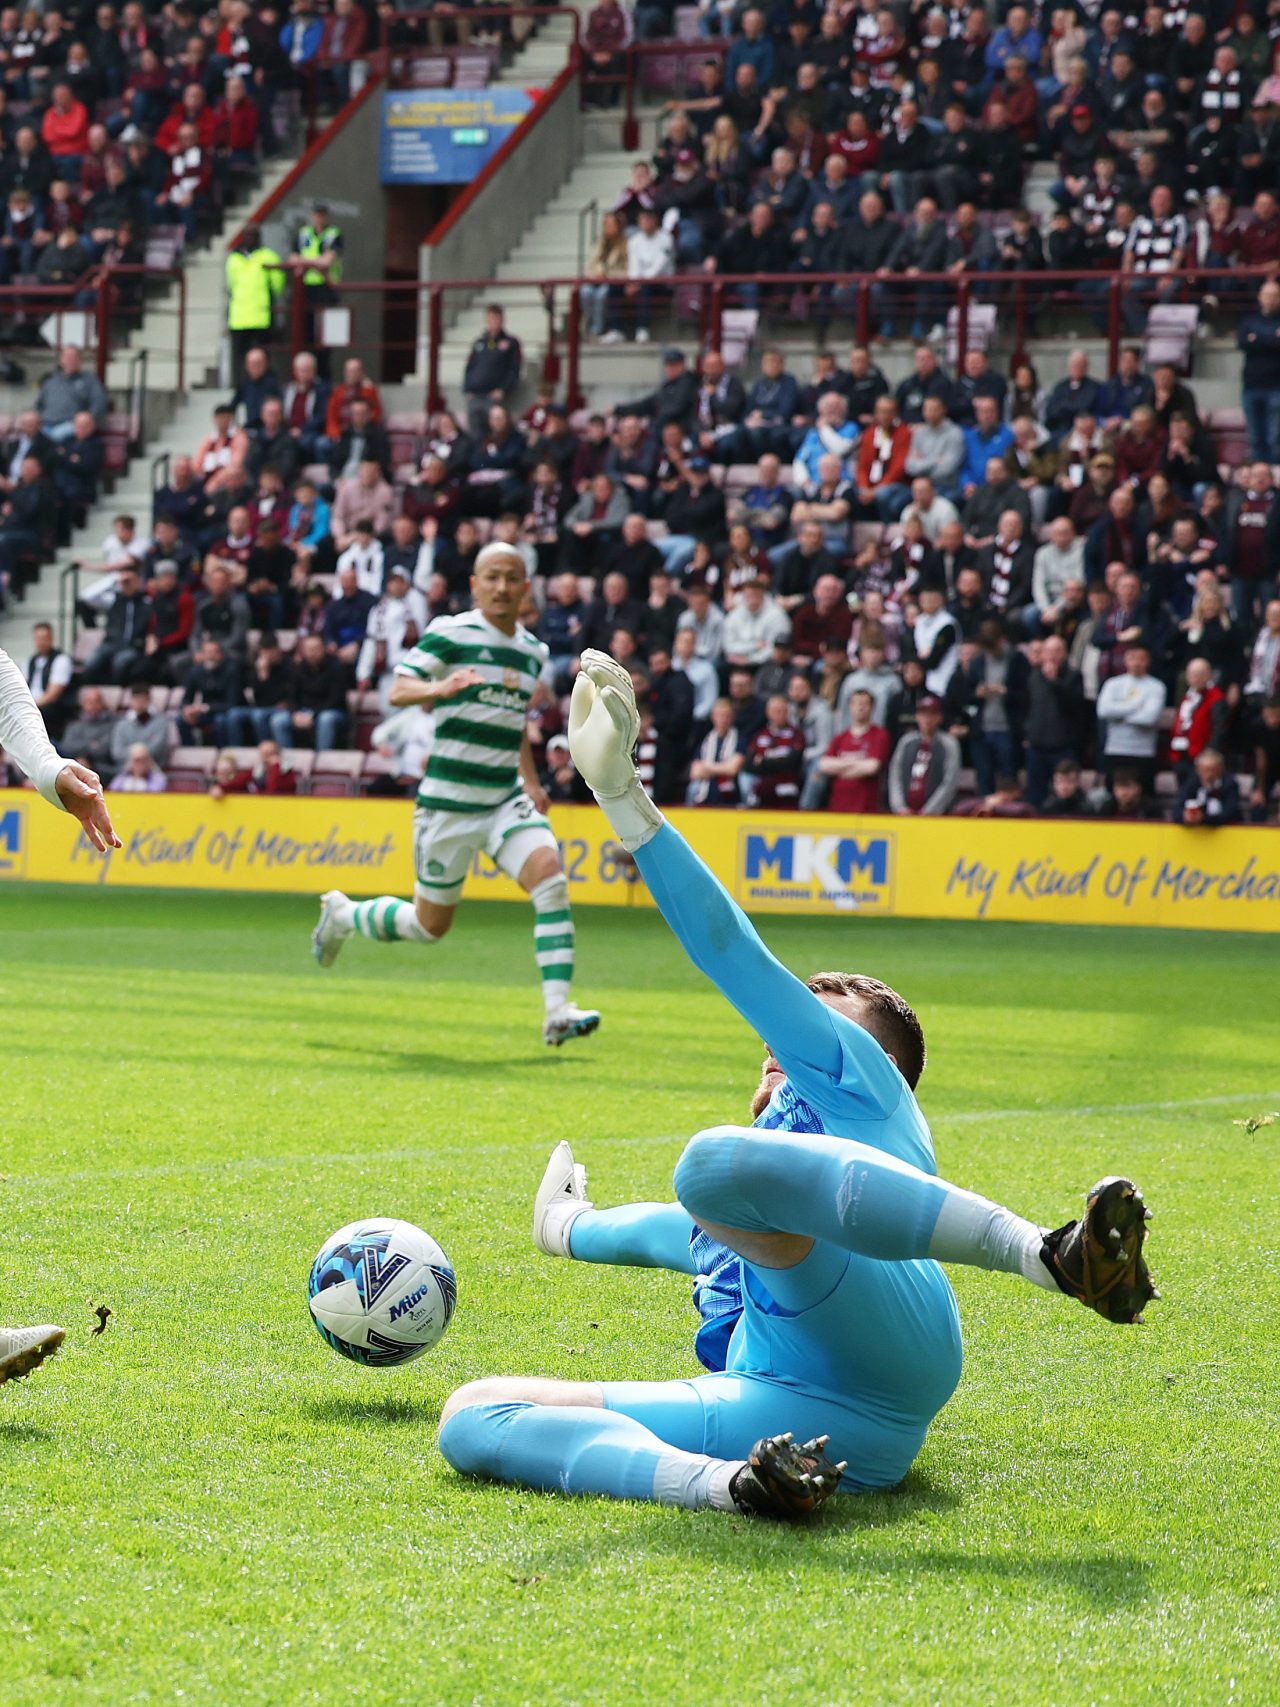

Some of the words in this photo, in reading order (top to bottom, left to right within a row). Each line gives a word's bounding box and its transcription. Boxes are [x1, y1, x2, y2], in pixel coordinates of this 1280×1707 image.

[124, 824, 206, 868] Kind
[206, 824, 245, 872] Of
[247, 823, 394, 869] Merchant
[746, 834, 888, 910] MKM
[946, 856, 999, 919] My
[1008, 853, 1102, 900] Kind
[1103, 855, 1148, 907] Of
[389, 1284, 428, 1324] Mitre
